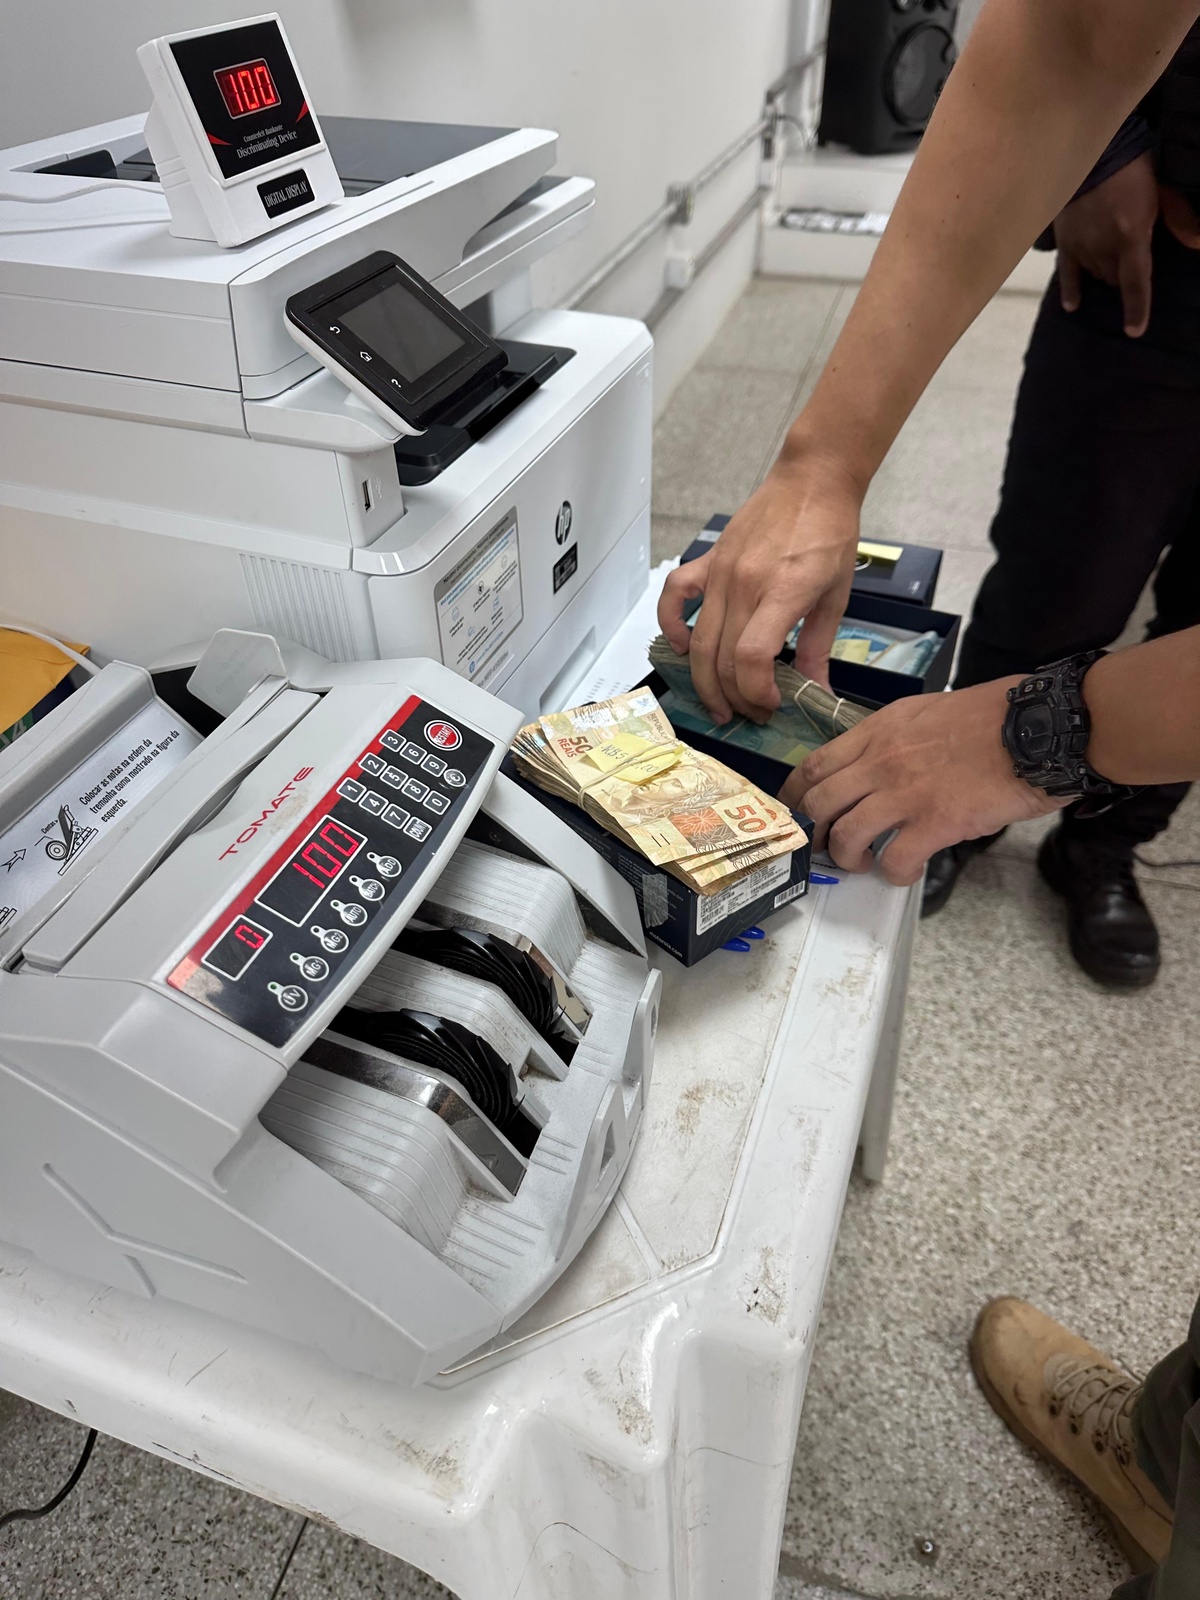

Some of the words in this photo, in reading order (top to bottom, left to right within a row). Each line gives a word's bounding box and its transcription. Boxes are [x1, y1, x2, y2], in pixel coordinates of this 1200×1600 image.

[230, 66, 276, 112] 100
[236, 136, 280, 159] Discriminating
[278, 130, 299, 144] Device
[243, 129, 266, 143] Counterfeit
[264, 124, 284, 136] Banknote
[264, 189, 288, 208] DIGITAL
[285, 181, 309, 199] DISPLAY
[555, 500, 573, 545] hp
[557, 738, 578, 758] REAIS
[79, 784, 103, 805] Colocar
[100, 778, 110, 788] as
[106, 765, 124, 782] notas
[120, 758, 131, 769] na
[127, 743, 146, 762] ordem
[142, 738, 153, 748] da
[89, 788, 118, 814] tremonha
[114, 775, 131, 792] como
[128, 755, 154, 779] mostrado
[150, 748, 160, 758] na
[156, 735, 174, 752] figura
[170, 729, 180, 739] da
[347, 784, 358, 793] 1
[367, 759, 380, 770] 2
[387, 736, 399, 745] 3
[368, 798, 380, 808] 4
[388, 772, 401, 782] 5
[408, 748, 420, 757] 6
[389, 811, 401, 821] 7
[410, 785, 422, 794] 8
[428, 761, 440, 770] 9
[409, 819, 428, 838] COUNT
[431, 798, 443, 807] 0
[449, 772, 461, 782] C
[101, 797, 128, 823] esquerda.
[218, 767, 315, 861] TOMATE
[724, 804, 767, 833] 50
[292, 822, 359, 889] 100
[384, 858, 396, 874] ADD
[366, 881, 380, 898] BATCH
[350, 906, 362, 923] AUTO
[234, 924, 264, 949] 0
[326, 932, 344, 950] MG2
[649, 931, 683, 958] motorola.com
[306, 959, 324, 977] MG1
[284, 988, 302, 1006] UV
